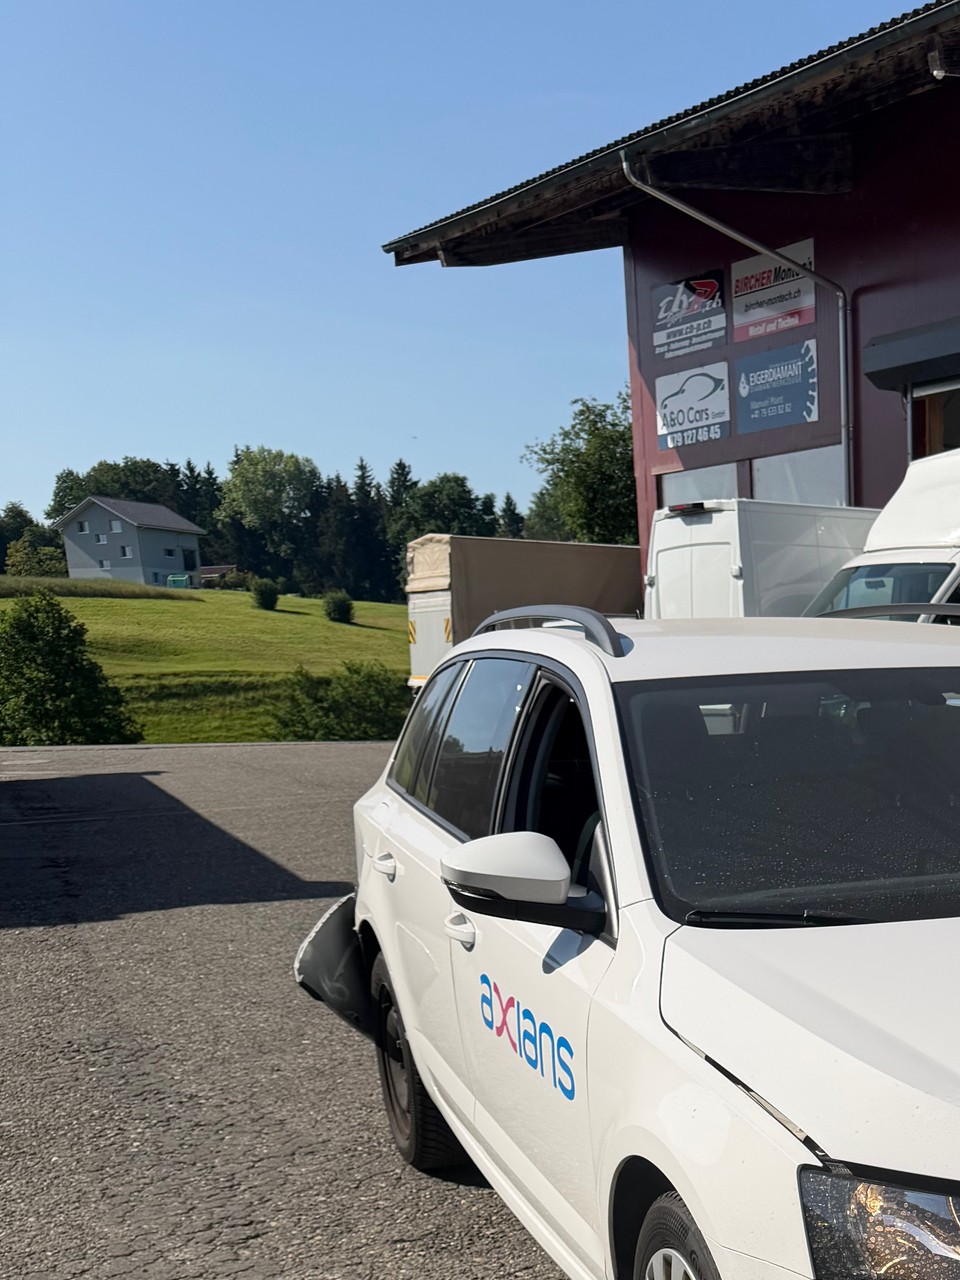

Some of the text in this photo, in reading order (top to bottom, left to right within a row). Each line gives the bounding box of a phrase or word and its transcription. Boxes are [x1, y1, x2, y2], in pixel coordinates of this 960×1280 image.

[734, 268, 773, 295] BIRCHER
[661, 408, 686, 430] A&O
[687, 406, 710, 424] Cars
[667, 433, 683, 449] 079
[683, 429, 697, 445] 127
[709, 424, 722, 440] 45
